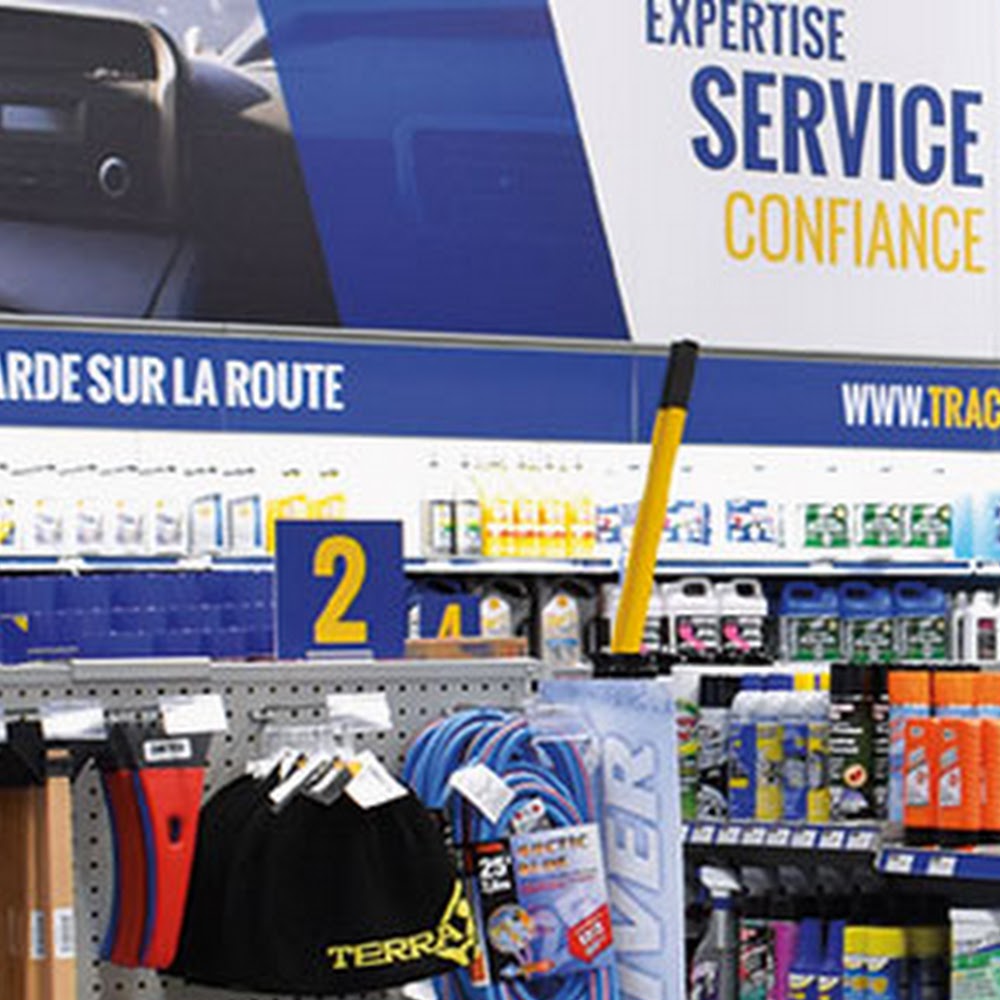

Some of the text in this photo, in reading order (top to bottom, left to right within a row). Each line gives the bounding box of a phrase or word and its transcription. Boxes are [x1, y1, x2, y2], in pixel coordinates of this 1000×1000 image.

[646, 0, 845, 61] EXPERTISE
[691, 65, 984, 188] SERVICE
[724, 190, 986, 274] CONFIANCE
[0, 350, 345, 411] RDE SUR LA ROUTE
[314, 534, 367, 645] 2
